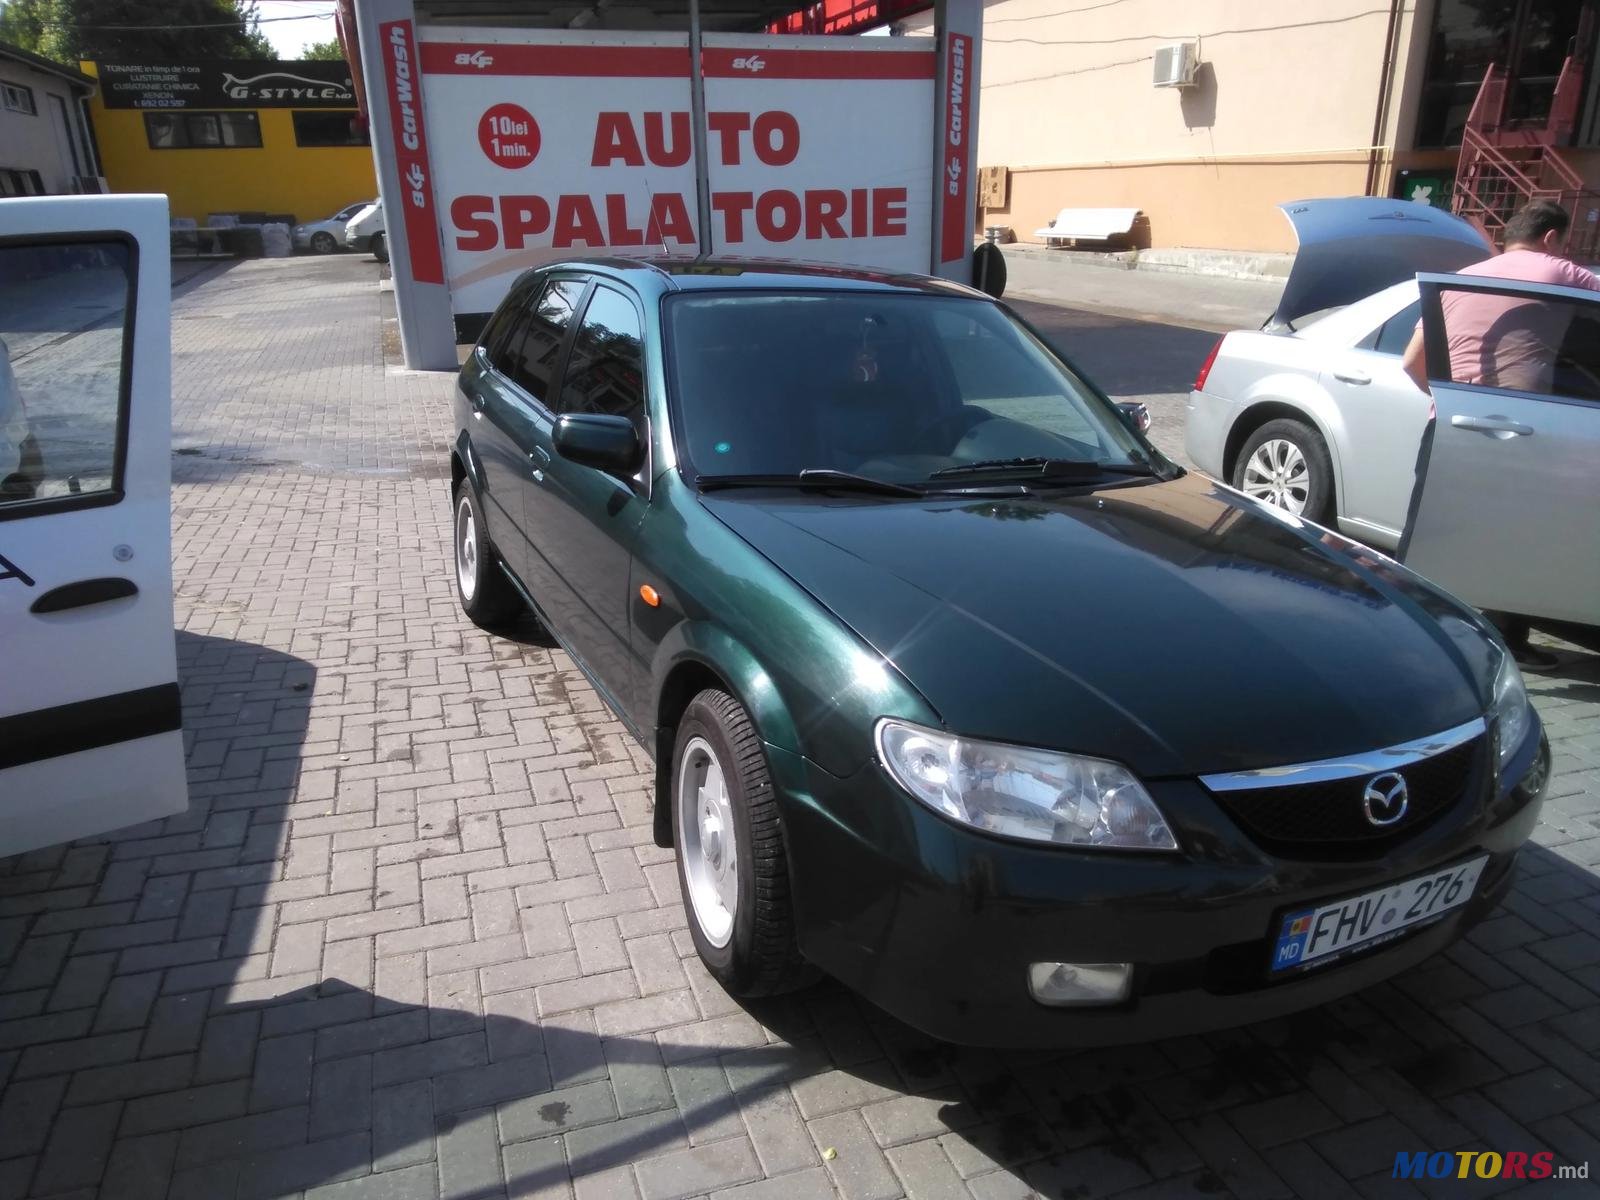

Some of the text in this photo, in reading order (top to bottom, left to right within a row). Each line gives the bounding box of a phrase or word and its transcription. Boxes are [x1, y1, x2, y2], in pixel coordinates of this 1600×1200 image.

[105, 65, 143, 73] TONARE
[171, 65, 181, 73] de
[591, 110, 800, 168] AUTO
[450, 187, 907, 251] SPALATORIE
[1308, 894, 1386, 953] FHV
[1403, 868, 1467, 920] 276
[1279, 942, 1299, 962] MD
